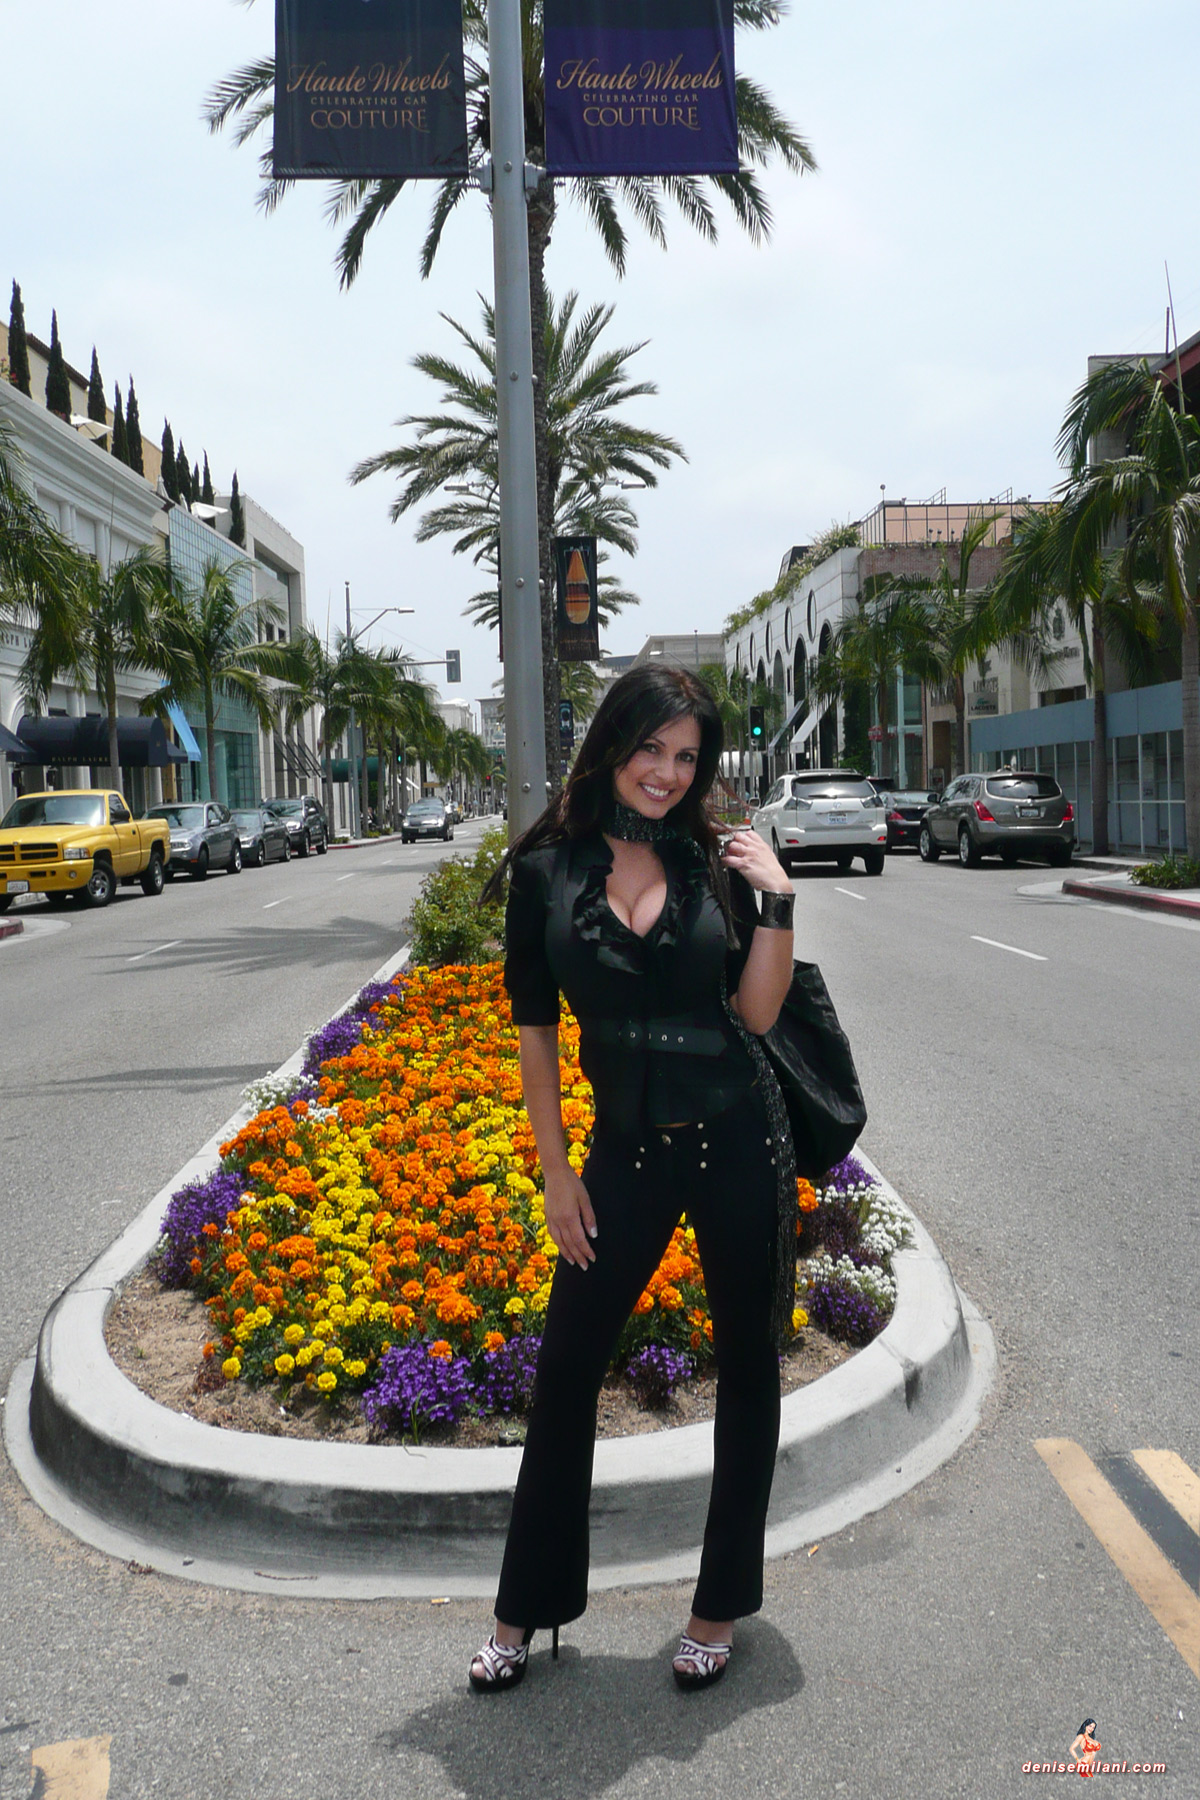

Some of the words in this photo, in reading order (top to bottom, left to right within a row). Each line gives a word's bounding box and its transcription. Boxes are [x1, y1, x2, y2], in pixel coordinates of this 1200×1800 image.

[286, 60, 366, 93] Haute
[368, 53, 452, 92] Wheels
[556, 57, 638, 90] Haute
[639, 51, 723, 90] Wheels
[311, 96, 398, 105] CELEBRATING
[404, 95, 428, 105] CAR
[583, 93, 668, 103] CELEBRATING
[675, 93, 699, 102] CAR
[310, 109, 431, 133] COUTURE
[583, 106, 701, 130] COUTURE
